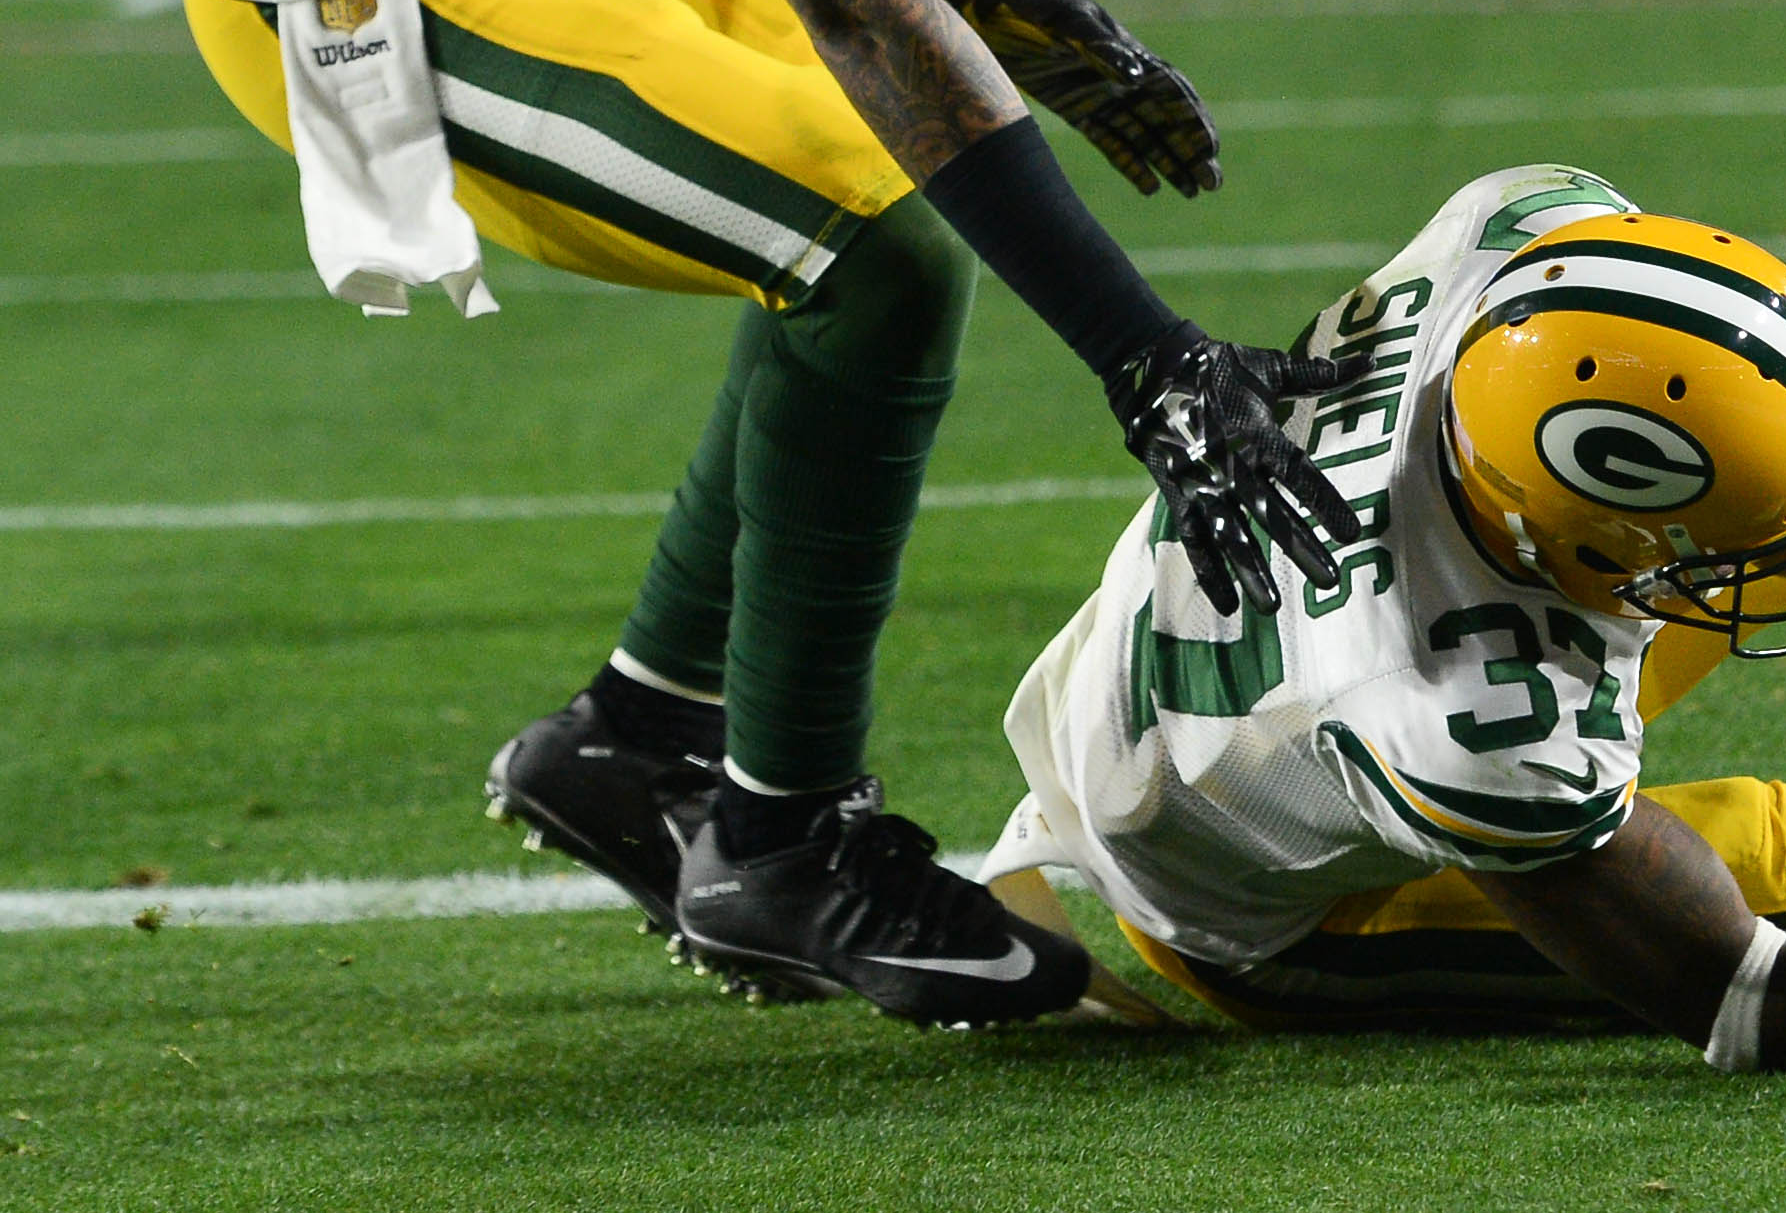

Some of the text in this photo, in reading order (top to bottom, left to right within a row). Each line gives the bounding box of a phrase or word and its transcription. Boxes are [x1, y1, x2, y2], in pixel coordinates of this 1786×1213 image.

[312, 39, 391, 66] Wilson
[1534, 398, 1715, 513] G
[1428, 602, 1627, 755] 37
